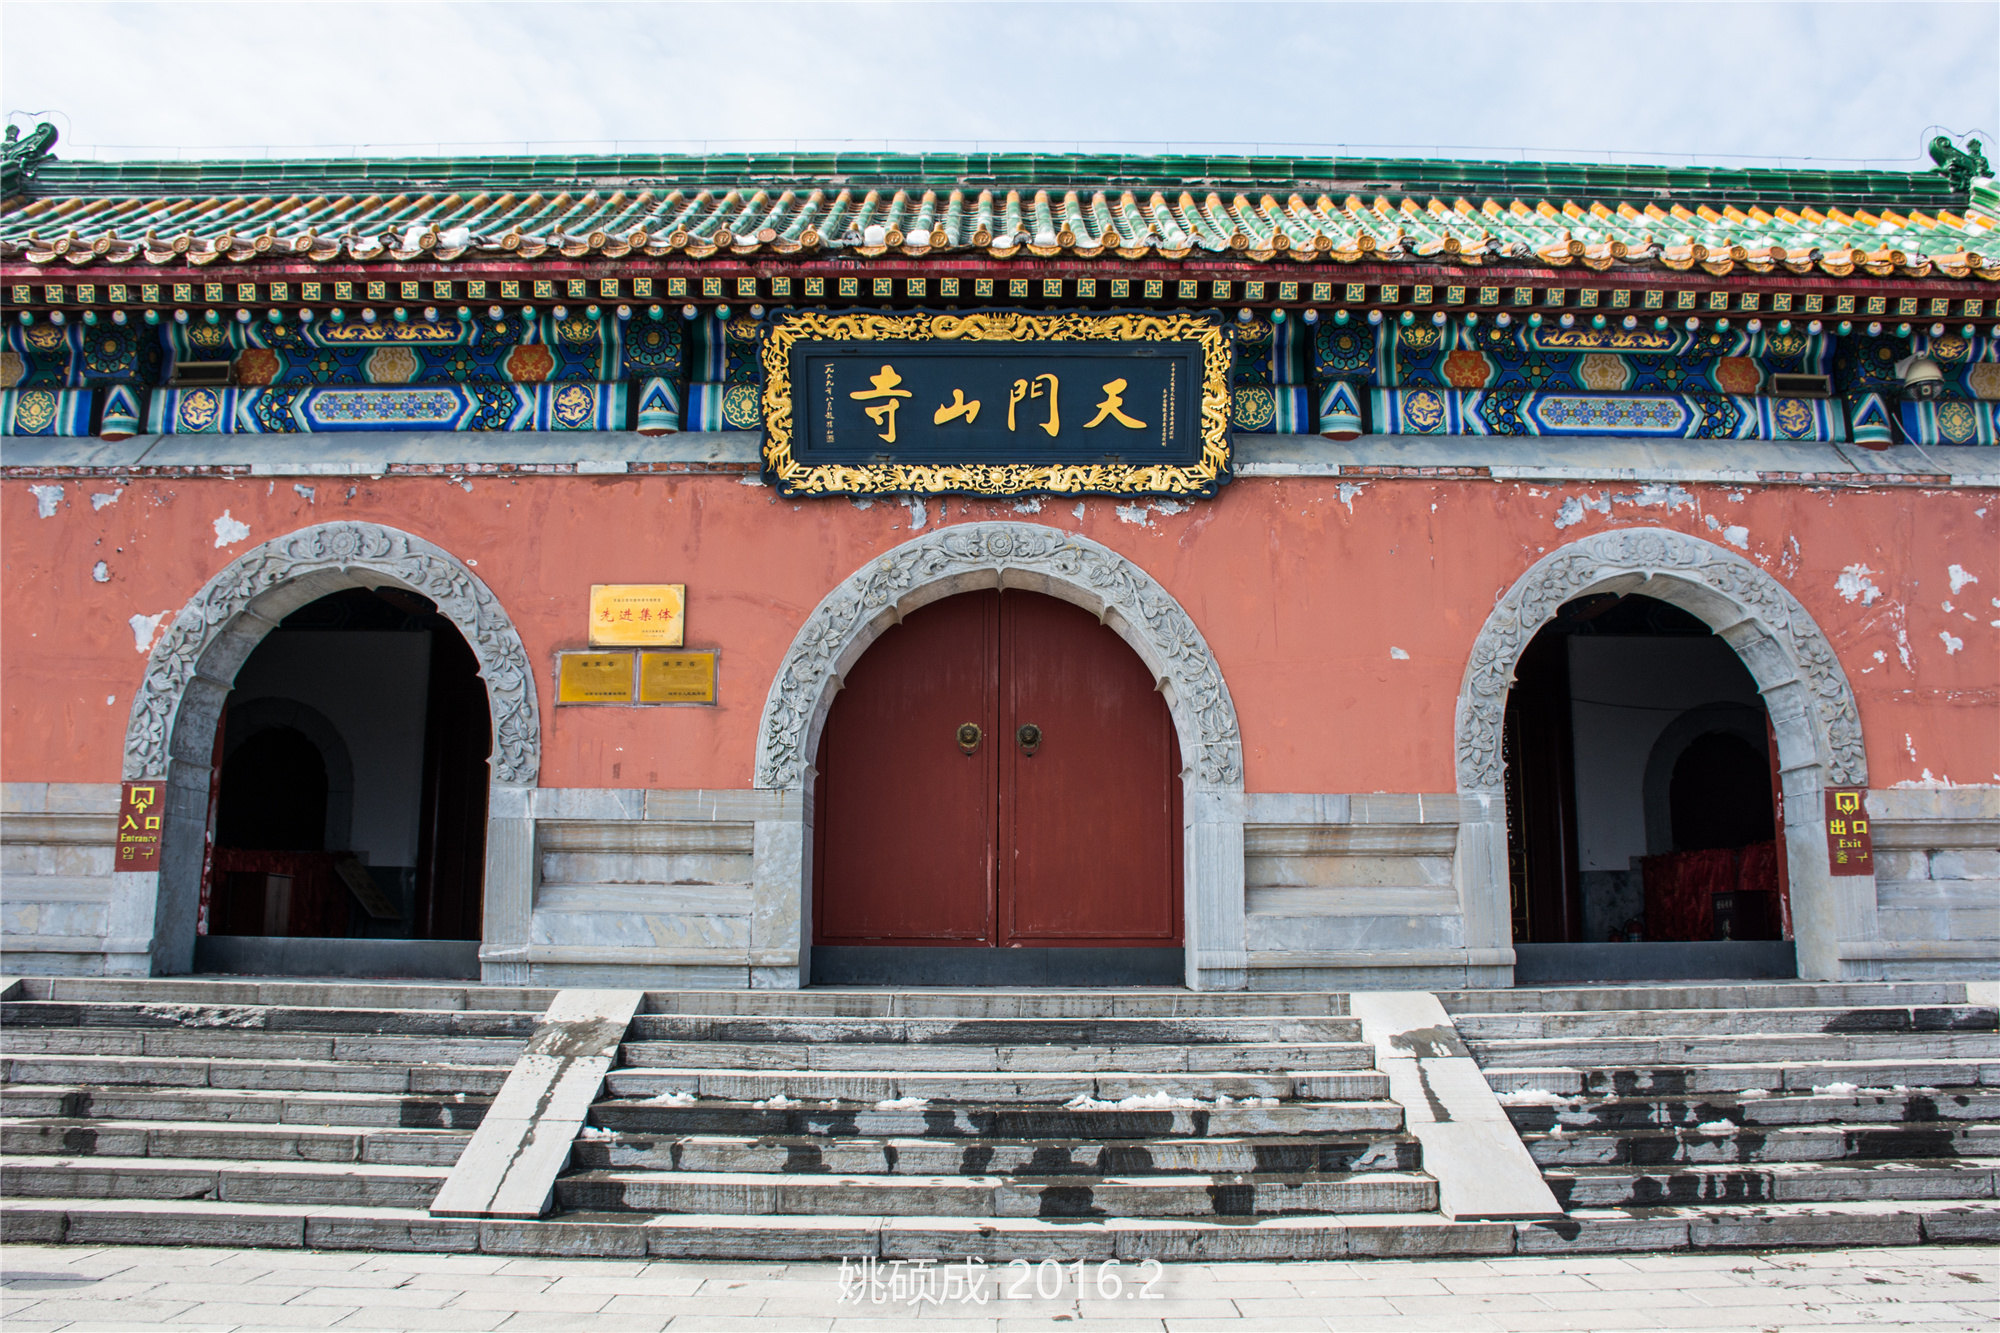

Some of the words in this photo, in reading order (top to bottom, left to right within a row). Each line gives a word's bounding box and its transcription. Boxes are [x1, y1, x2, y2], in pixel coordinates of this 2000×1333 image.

[600, 607, 673, 622] 先进集体
[121, 814, 160, 830] 入口
[1830, 818, 1867, 835] 出口
[120, 833, 157, 843] Entrance
[1839, 838, 1862, 848] Exit
